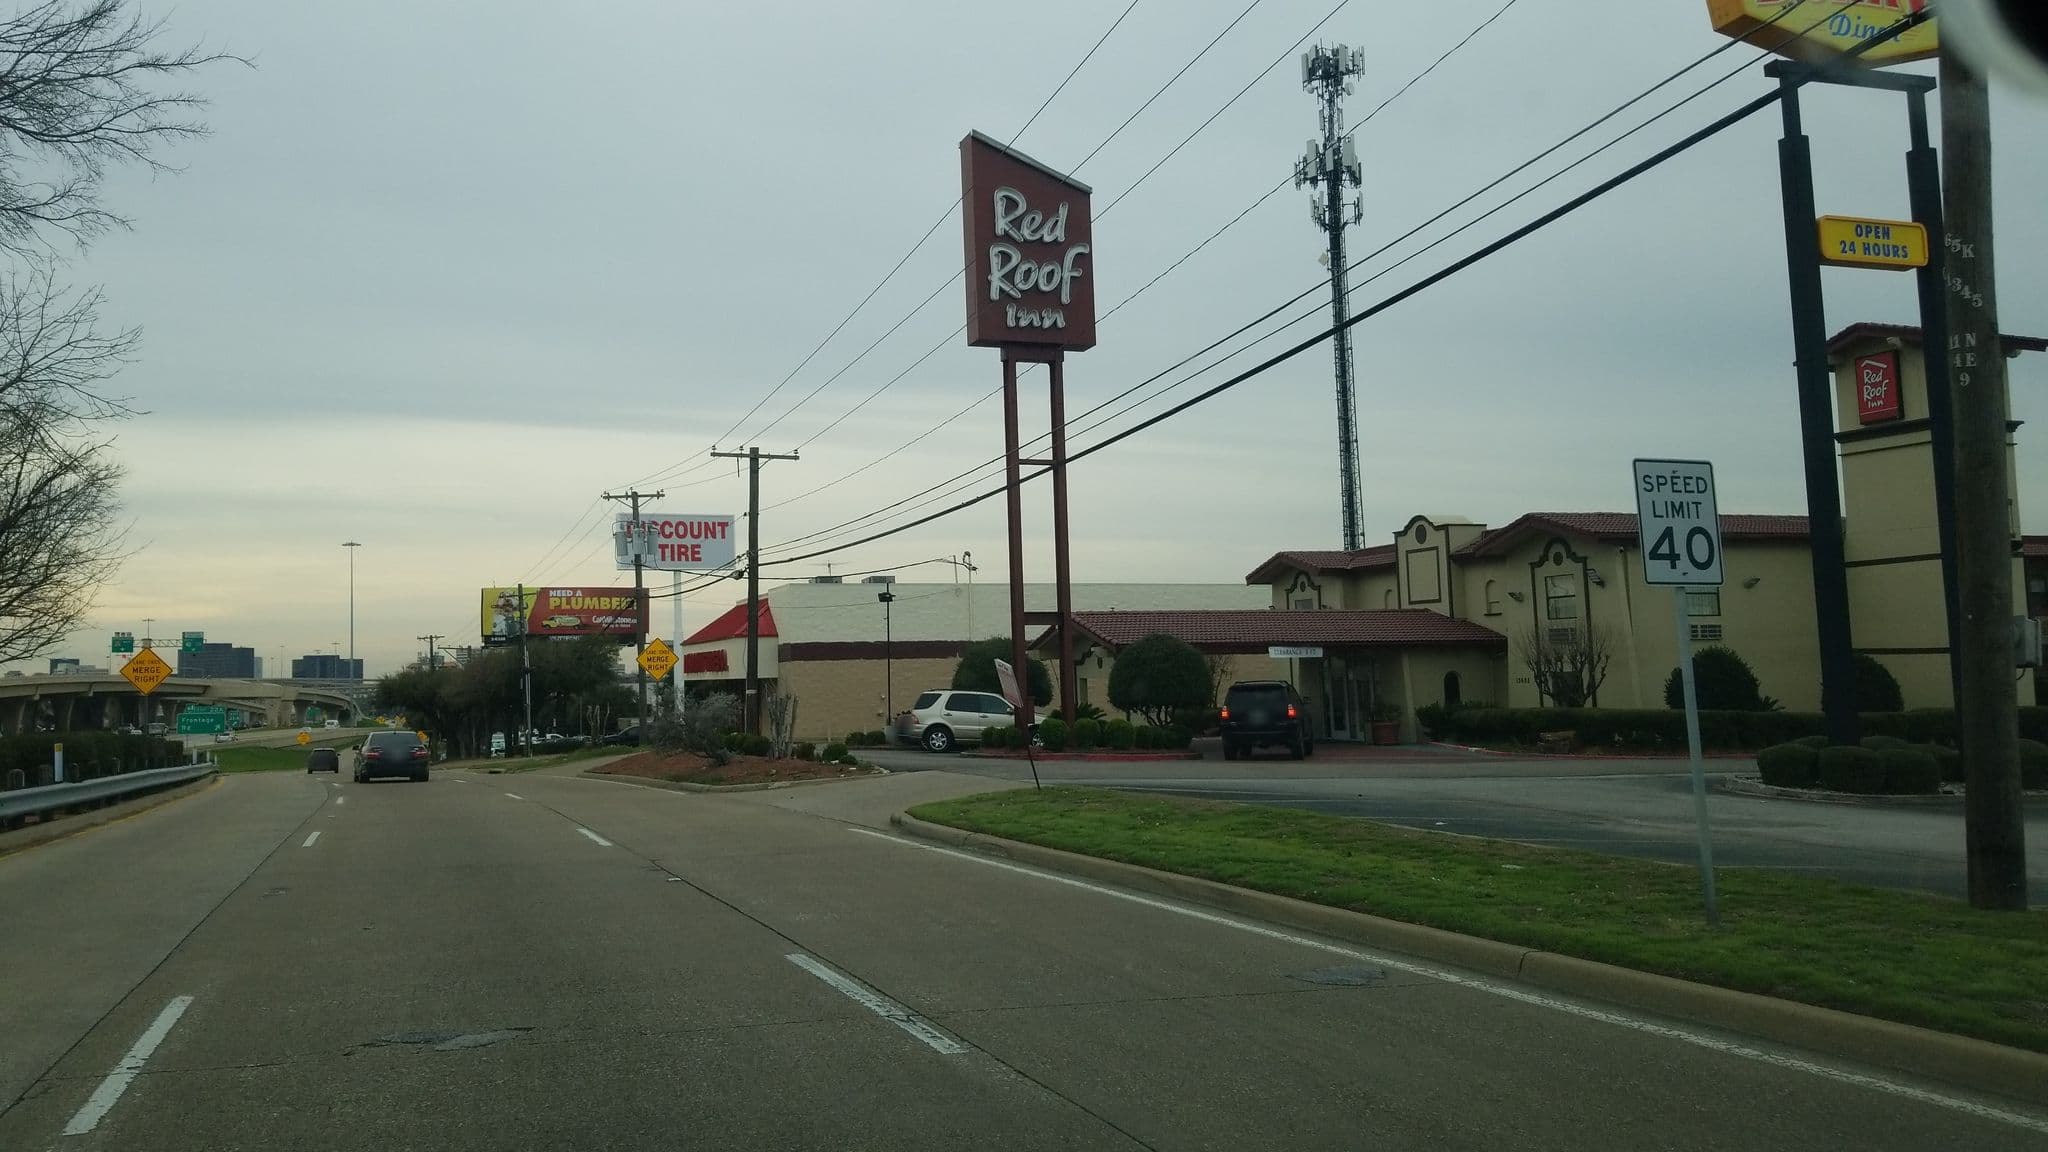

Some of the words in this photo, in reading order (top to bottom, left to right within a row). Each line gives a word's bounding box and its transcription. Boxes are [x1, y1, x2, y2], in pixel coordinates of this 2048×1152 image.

[1829, 14, 1901, 43] Din
[993, 185, 1069, 243] Red
[1855, 223, 1891, 240] OPEN
[1839, 240, 1857, 254] 24
[1862, 242, 1909, 259] HOURS
[987, 242, 1090, 305] Roof
[1863, 368, 1883, 384] Red
[1863, 379, 1889, 401] Roof
[1867, 399, 1884, 409] Inn
[1642, 474, 1708, 494] SPEED
[1651, 500, 1703, 520] LIMIT
[657, 543, 703, 562] TIRE
[1648, 526, 1715, 571] 40
[134, 675, 160, 683] RIGHT
